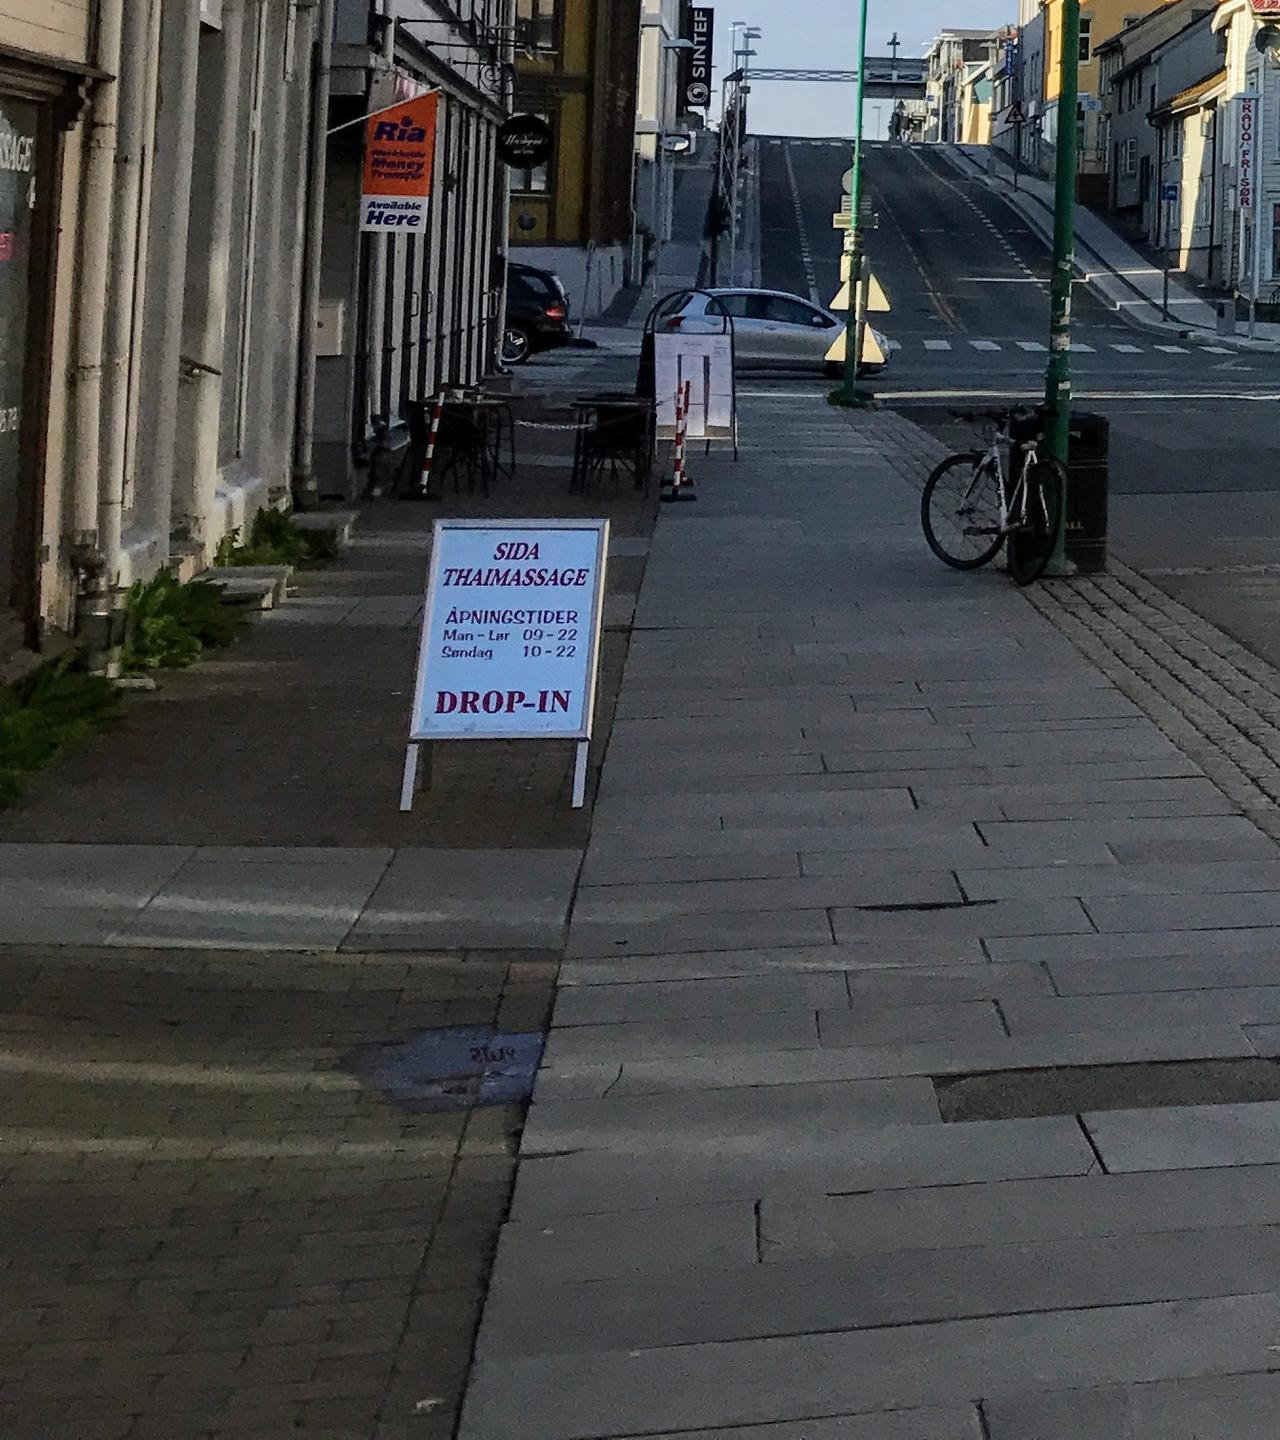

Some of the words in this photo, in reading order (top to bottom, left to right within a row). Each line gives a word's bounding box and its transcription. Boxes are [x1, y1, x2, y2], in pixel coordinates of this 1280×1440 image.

[692, 10, 707, 78] SINTEF
[374, 116, 426, 142] Ria
[371, 158, 425, 173] Money
[372, 169, 424, 181] Transfer
[1240, 150, 1250, 206] FRISØR
[367, 201, 421, 210] Available
[366, 210, 421, 226] Here
[493, 542, 540, 561] SIDA
[443, 568, 589, 587] THAIMASSAGE
[445, 607, 578, 624] ÅPNINGSTIDER
[442, 629, 474, 641] Man
[489, 629, 510, 641] Lør
[523, 629, 544, 641] 09
[557, 628, 578, 641] 22
[441, 645, 493, 660] Søndag
[523, 645, 541, 657] 10
[556, 645, 576, 658] 22
[435, 690, 572, 714] DROP-IN
